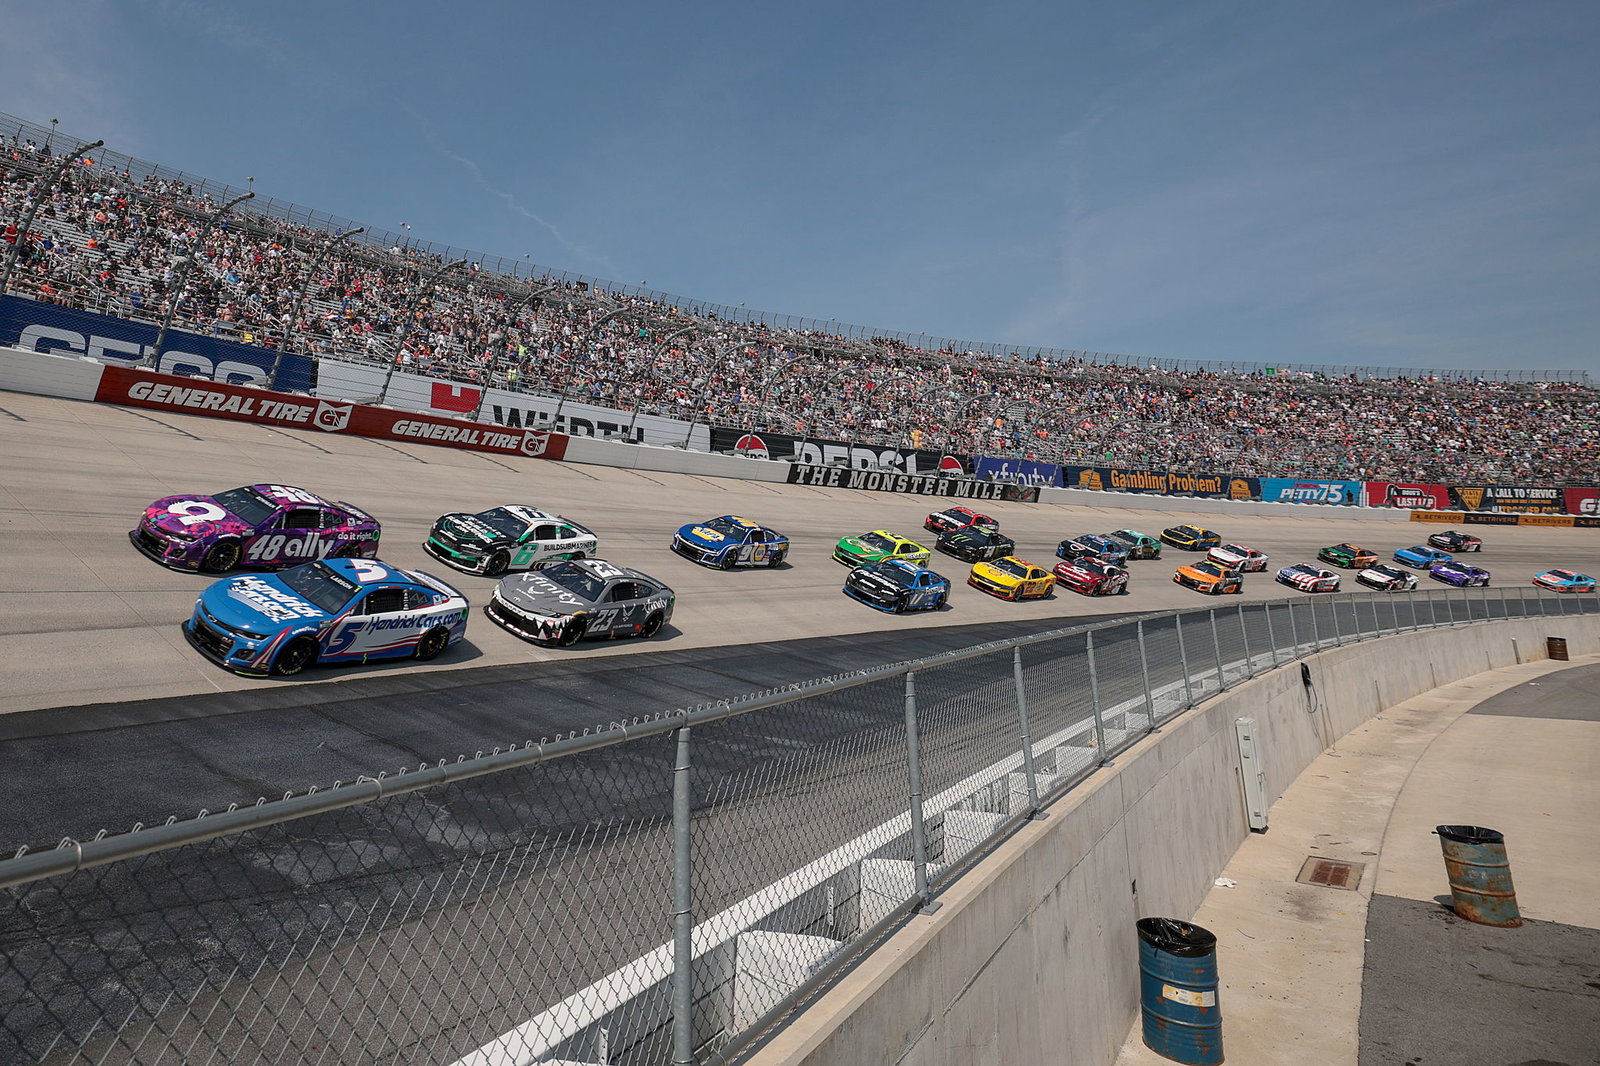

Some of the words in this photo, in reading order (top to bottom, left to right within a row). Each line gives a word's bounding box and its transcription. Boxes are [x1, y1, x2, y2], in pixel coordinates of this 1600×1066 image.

[127, 381, 255, 415] GENERAL
[256, 400, 314, 422] TIRE
[391, 420, 480, 445] GENERAL
[481, 430, 523, 450] TIRE
[795, 466, 840, 486] THE
[850, 469, 949, 496] MONSTER
[954, 480, 1004, 499] MILE
[1110, 470, 1167, 494] Gambling
[1168, 473, 1221, 492] Problem?
[1486, 488, 1493, 498] A
[1495, 488, 1513, 498] CALL
[1514, 489, 1525, 498] TO
[1396, 497, 1418, 507] LAST
[248, 534, 286, 561] 48
[284, 532, 335, 561] ally
[338, 532, 348, 540] do
[349, 532, 356, 540] it
[511, 542, 540, 565] 6
[330, 575, 353, 590] LARSON
[350, 559, 389, 583] 5
[588, 608, 619, 633] 23
[324, 621, 368, 656] 5
